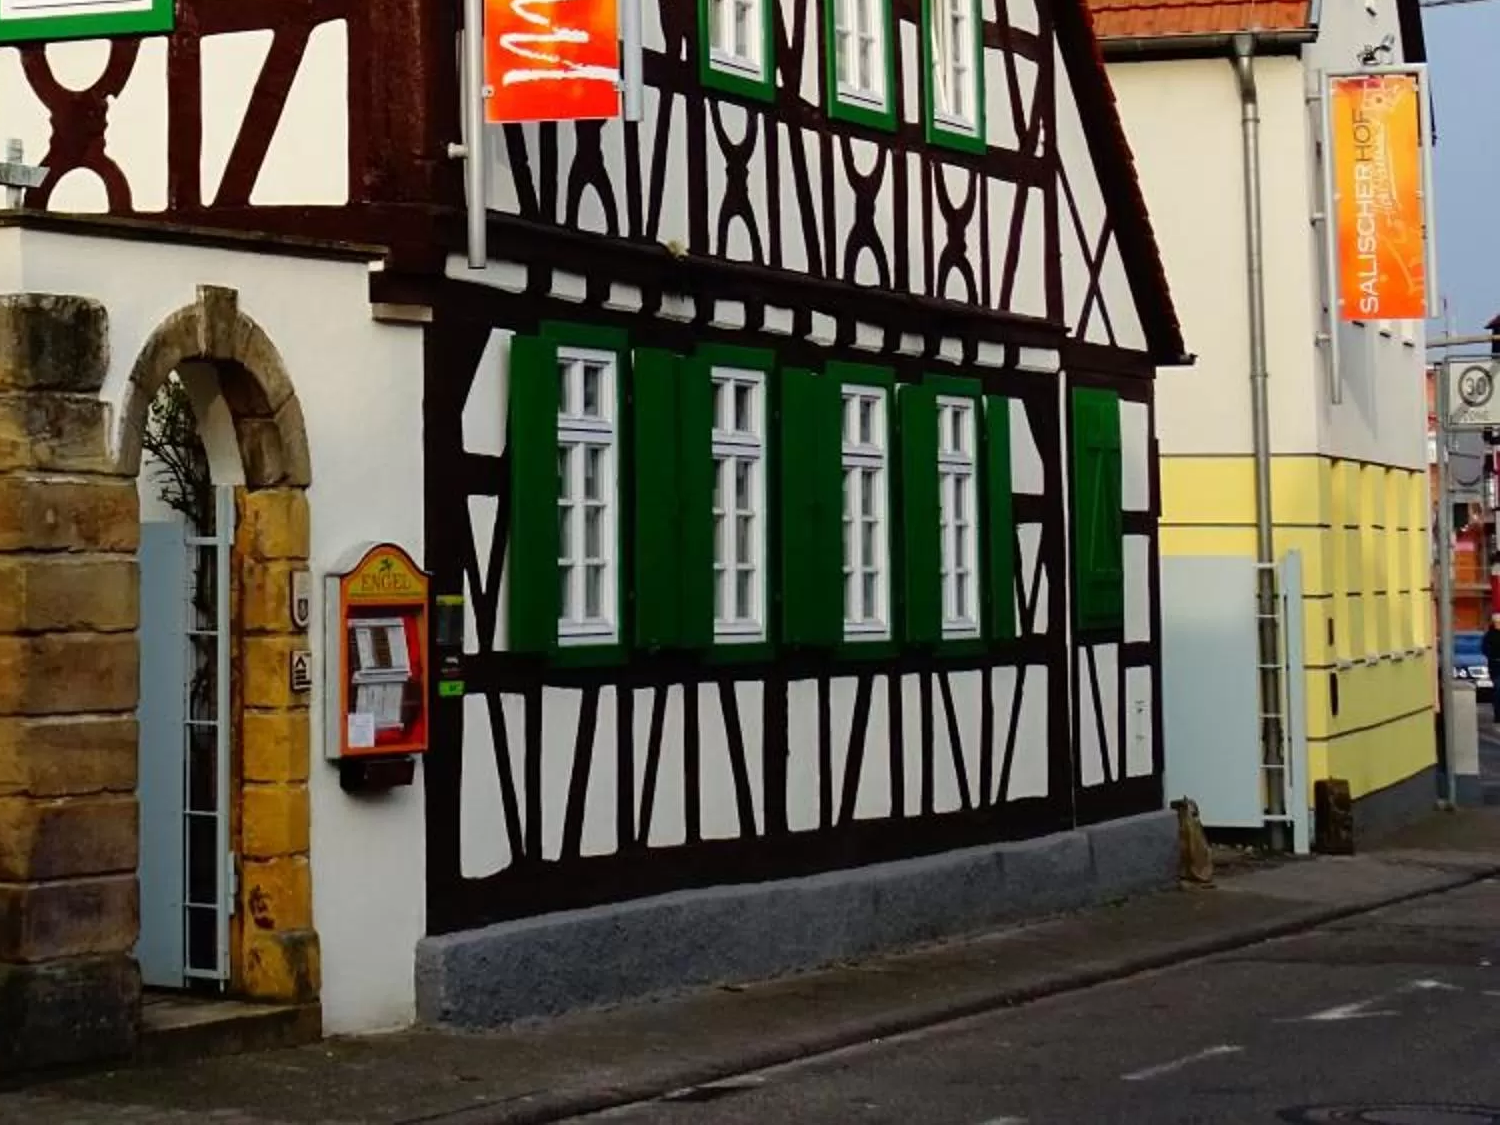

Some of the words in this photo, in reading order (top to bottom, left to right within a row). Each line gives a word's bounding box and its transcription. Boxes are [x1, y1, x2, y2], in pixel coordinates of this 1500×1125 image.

[1352, 108, 1379, 314] SALISCHERHOF
[1465, 376, 1487, 396] 30
[361, 573, 412, 592] ENGEL
